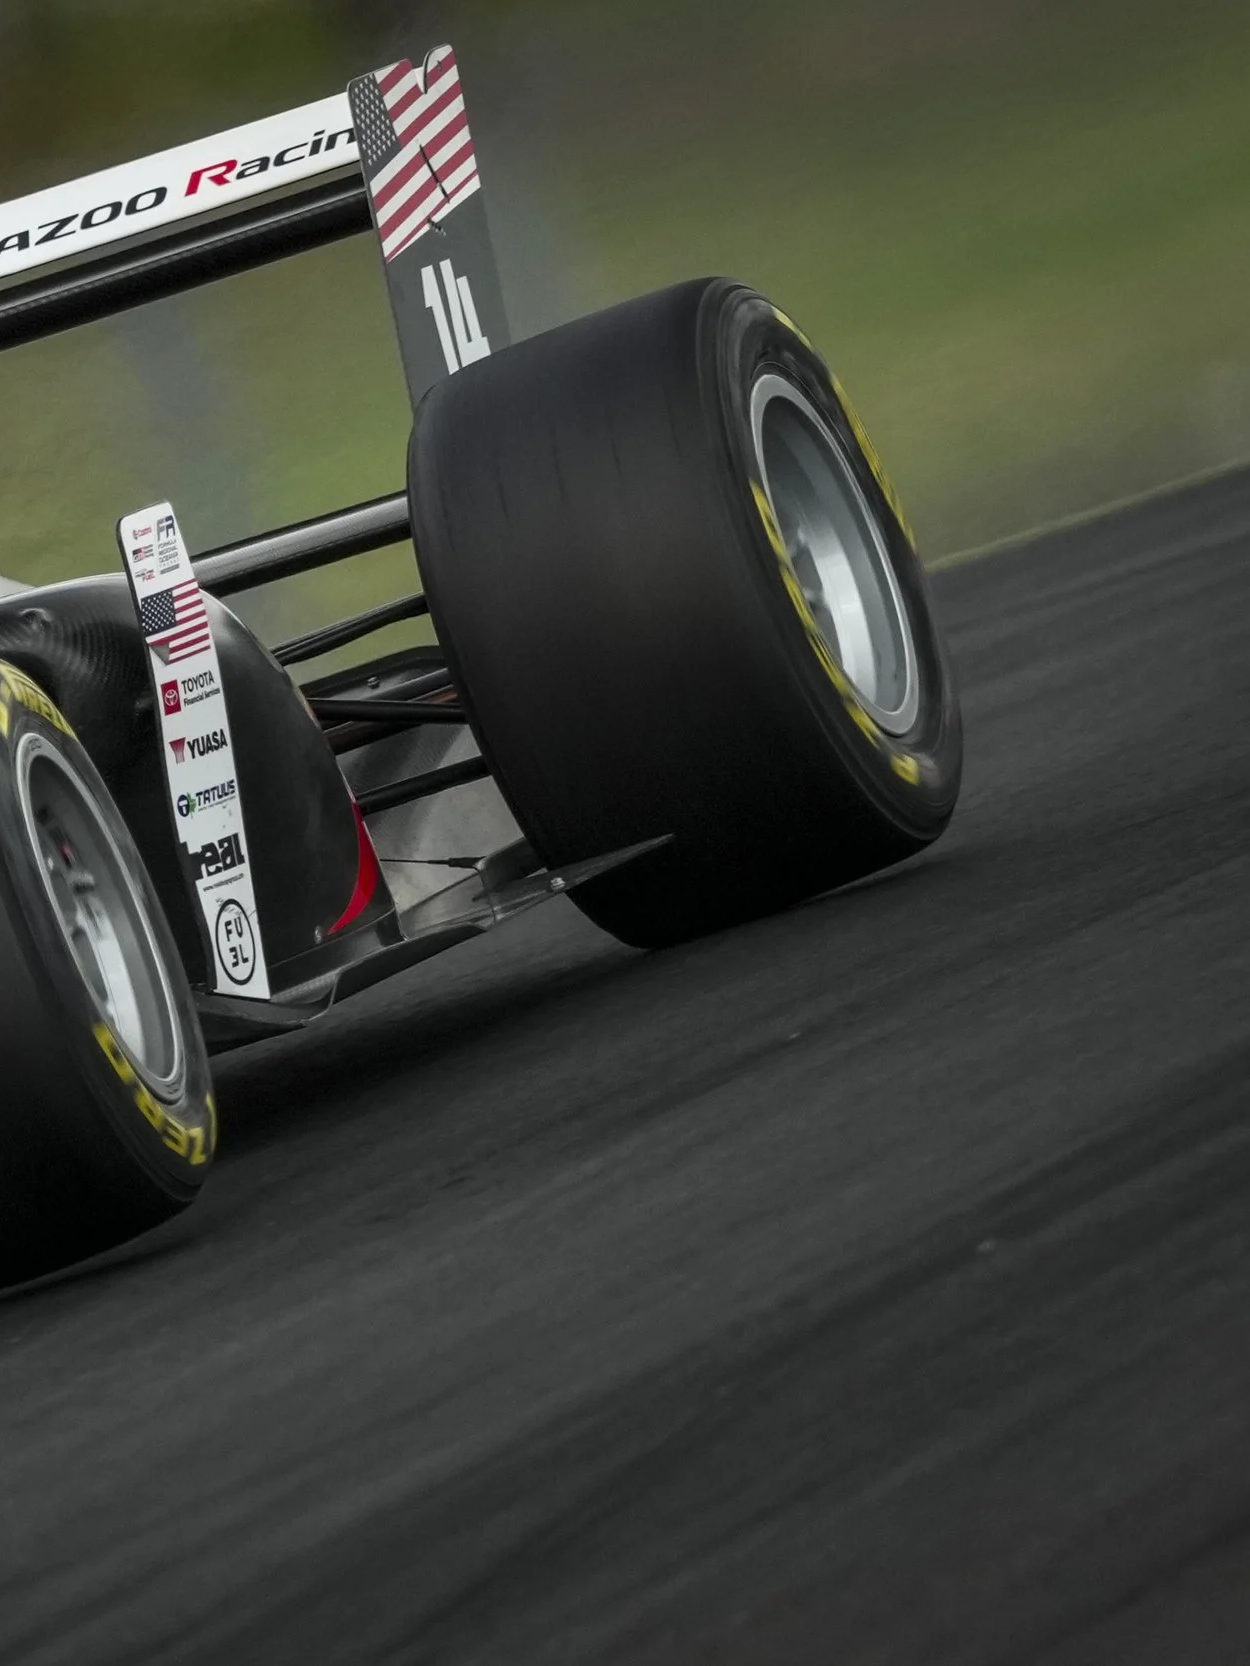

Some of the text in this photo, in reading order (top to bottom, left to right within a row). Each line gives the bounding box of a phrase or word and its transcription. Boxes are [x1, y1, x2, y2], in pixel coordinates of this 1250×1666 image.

[184, 128, 357, 197] Racin
[421, 259, 491, 375] 14
[181, 671, 215, 694] TOYOTA
[187, 729, 228, 760] YUASA
